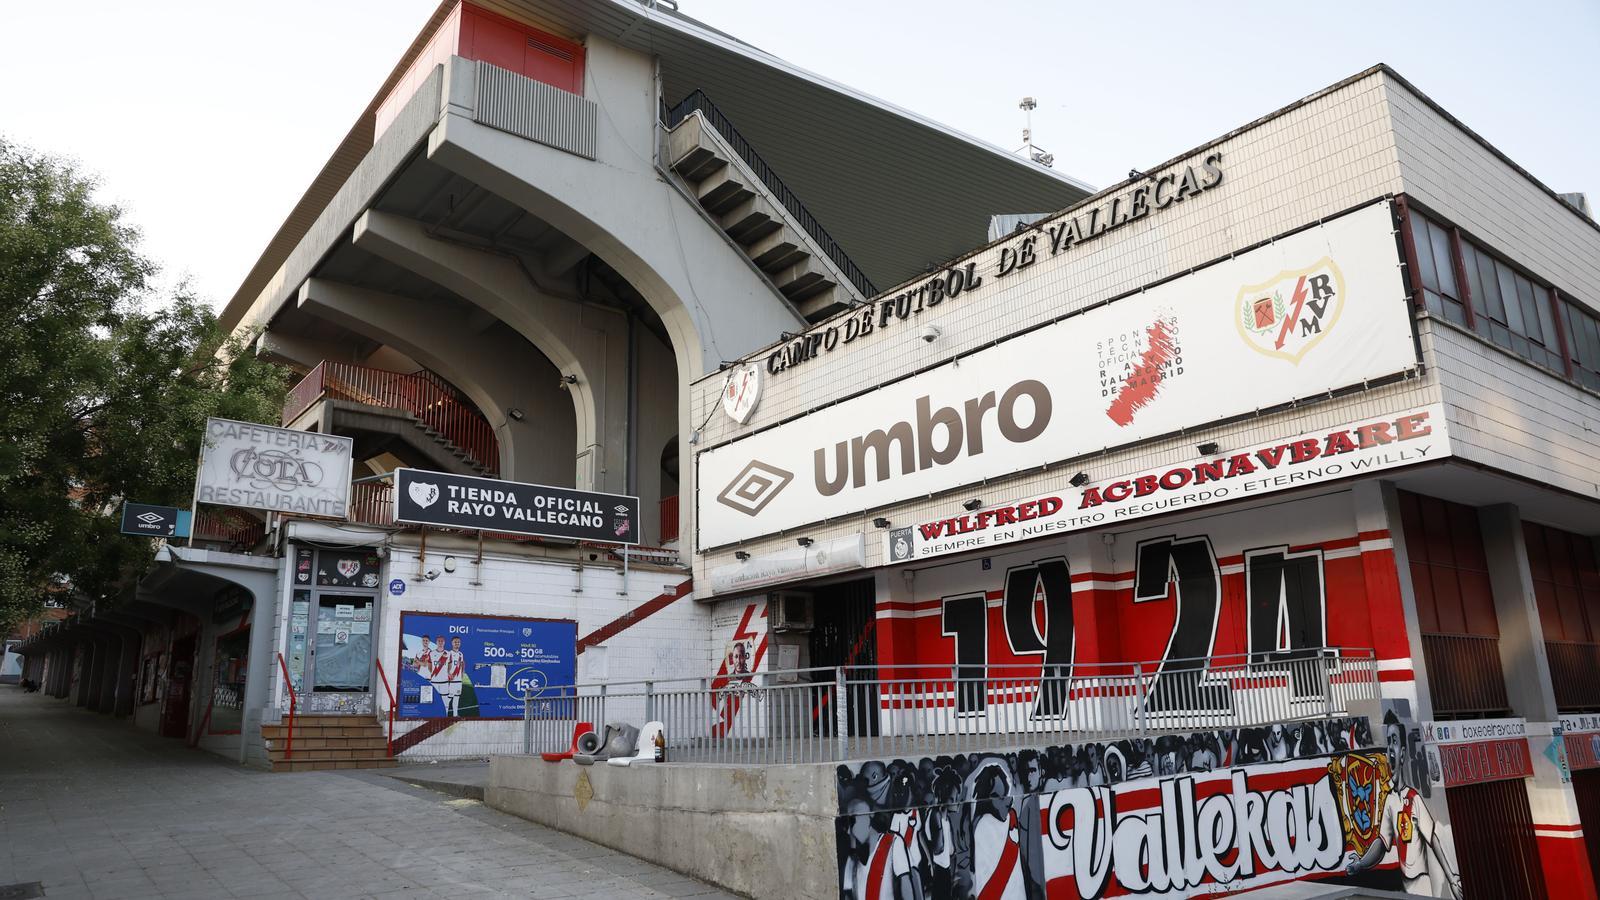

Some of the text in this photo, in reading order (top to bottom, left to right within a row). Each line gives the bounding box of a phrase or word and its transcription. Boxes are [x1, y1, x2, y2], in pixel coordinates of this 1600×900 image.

[767, 153, 1223, 375] CAMPO DE FUTBOL DE VALLECAS
[1101, 357, 1183, 387] VALLECANO
[1102, 367, 1184, 397] DE MADRID
[208, 422, 319, 450] CAFETERIA
[814, 379, 1053, 497] umbro
[918, 411, 1432, 541] WILFRED AGBONAVBARE
[200, 486, 345, 514] RESTAURANTE
[447, 485, 603, 514] TIENDA OFICIAL
[447, 501, 496, 517] RAYO
[502, 507, 603, 528] VALLECANO
[922, 444, 1432, 555] SIEMPRE EN NUESTRO RECUERDO ETERNO WILLY
[890, 528, 912, 538] PUERTA
[449, 625, 469, 634] DIGI
[941, 534, 1341, 722] 1924
[484, 647, 506, 658] 500
[521, 648, 535, 658] 50
[1047, 769, 1348, 900] Vallekas
